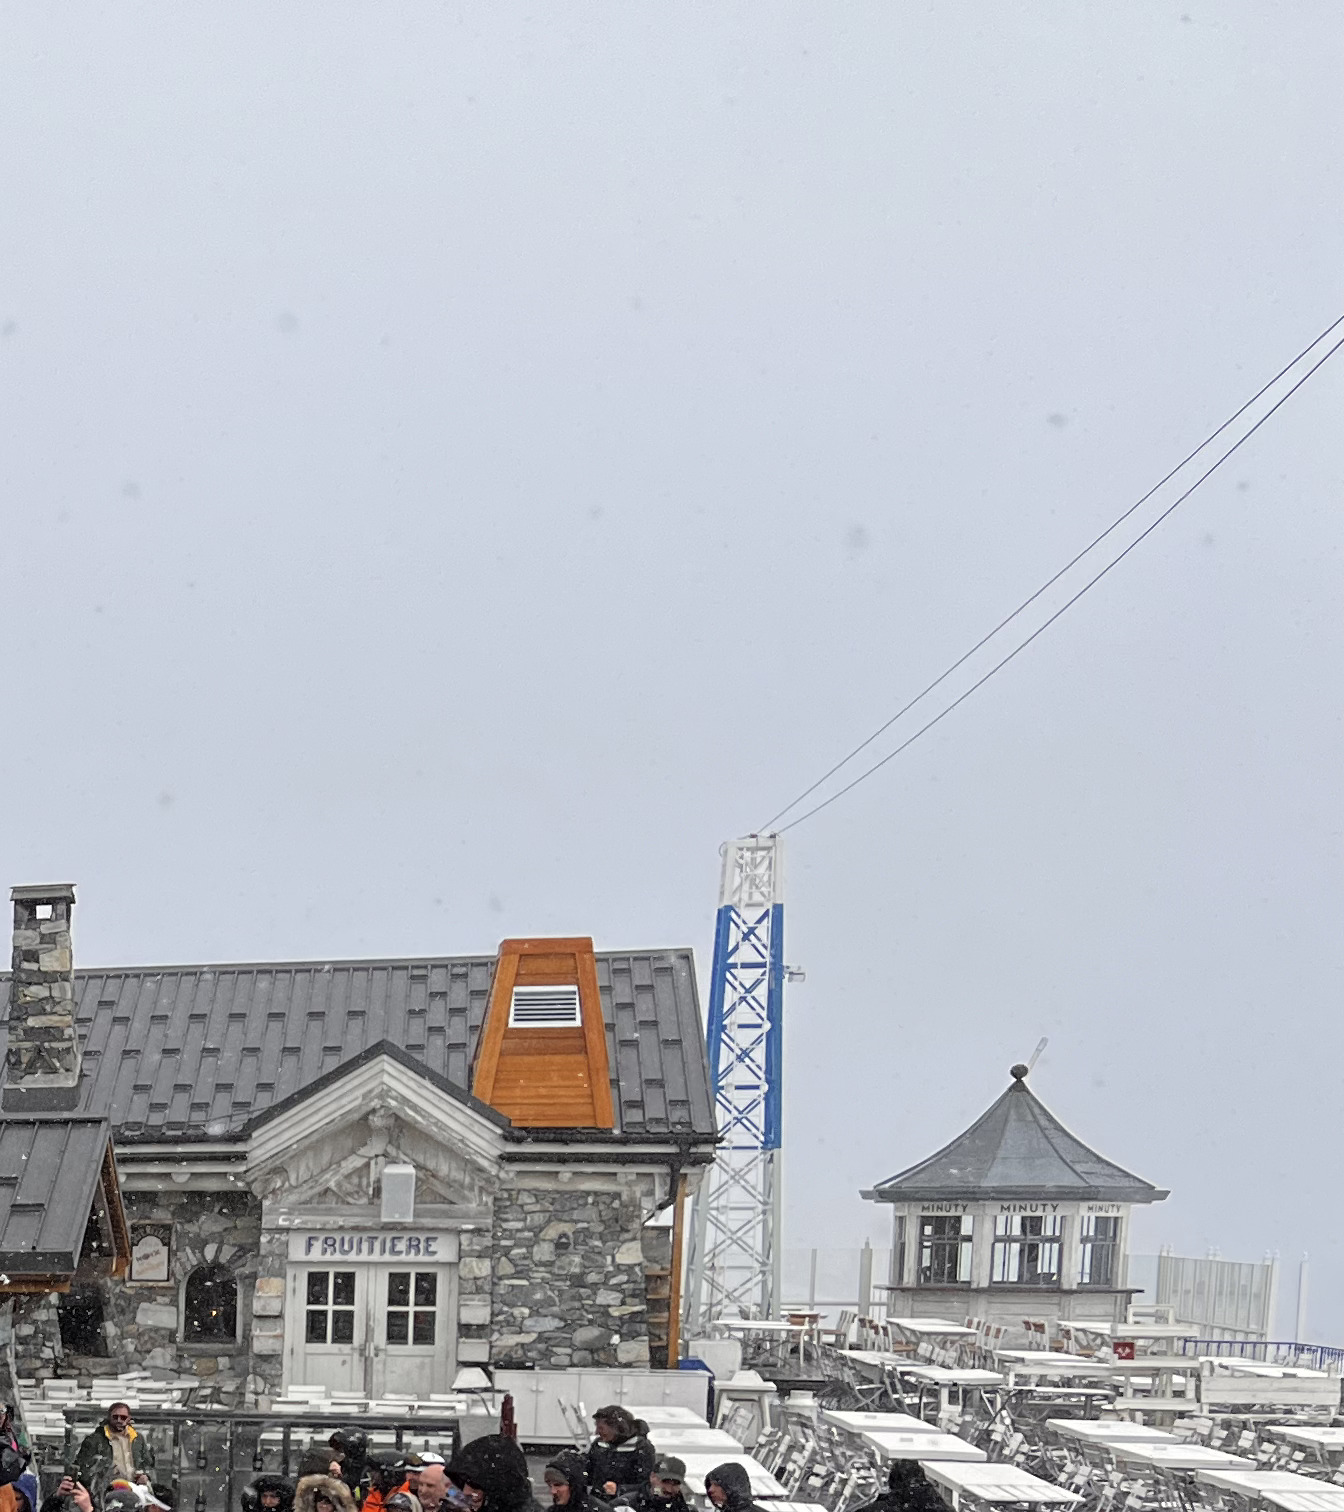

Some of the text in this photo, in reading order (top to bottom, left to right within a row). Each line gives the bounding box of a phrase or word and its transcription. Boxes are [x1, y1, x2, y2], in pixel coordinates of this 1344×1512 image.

[920, 1203, 969, 1213] MINUTY
[999, 1203, 1060, 1213] MINUTY
[1087, 1203, 1122, 1214] MINUTY
[303, 1234, 440, 1258] FRUITIERE
